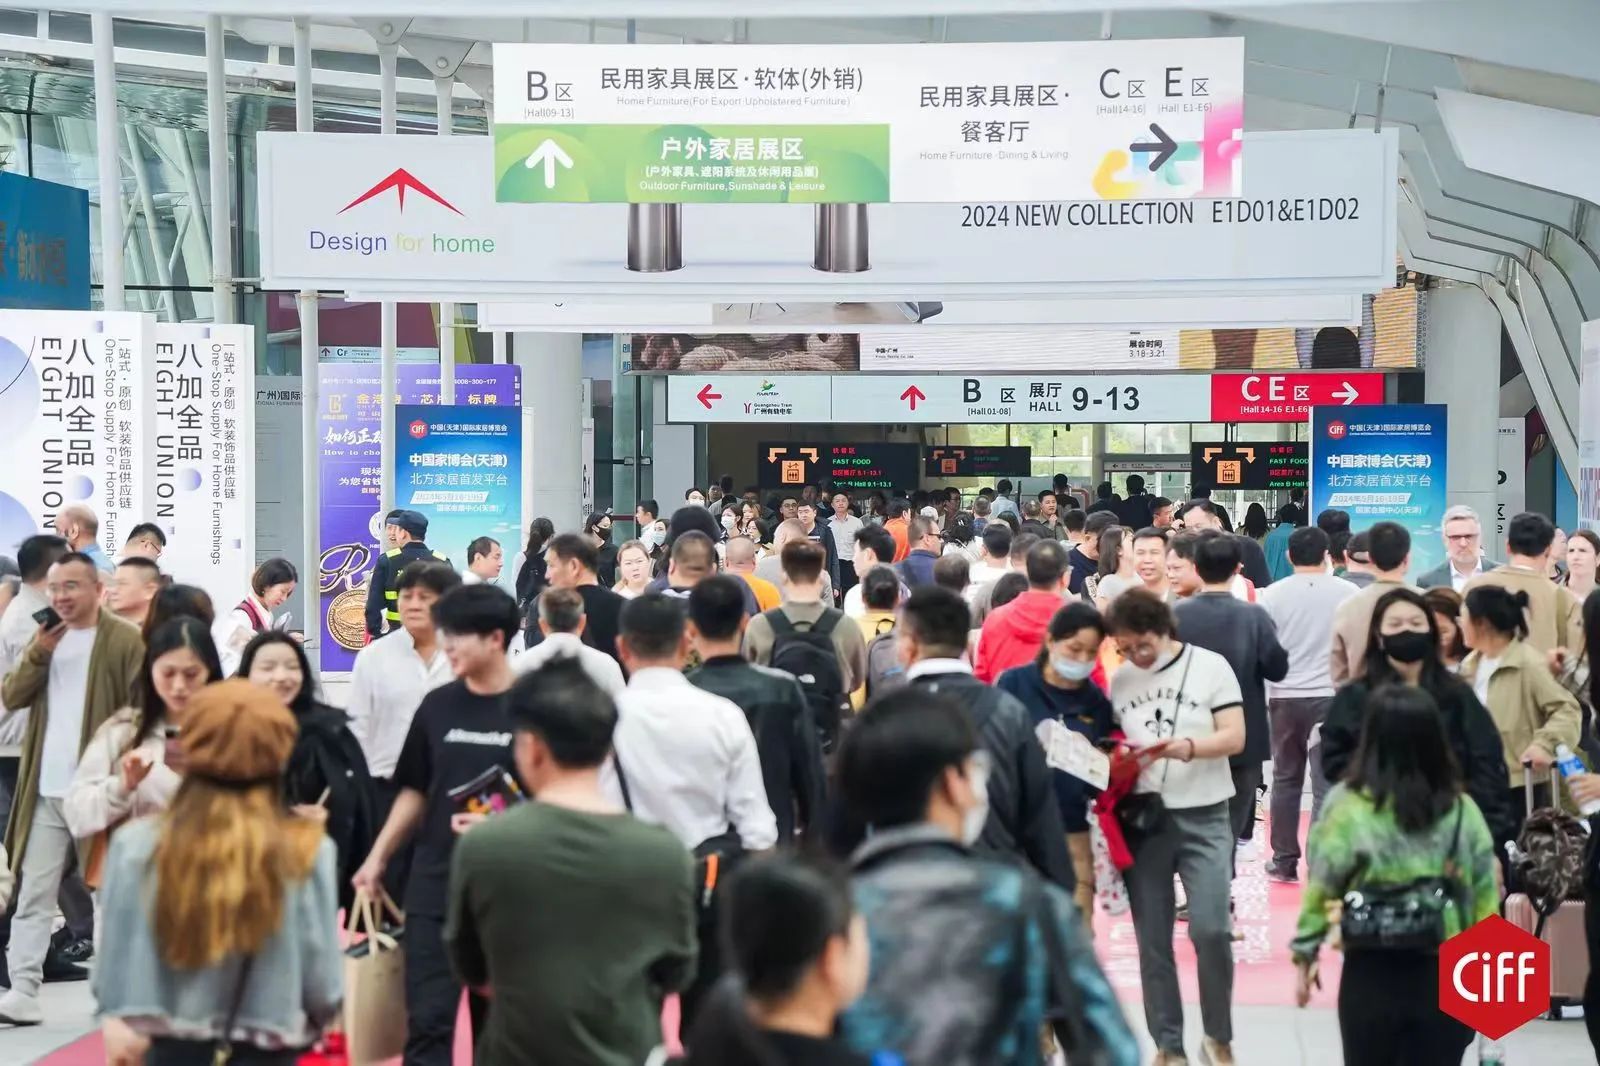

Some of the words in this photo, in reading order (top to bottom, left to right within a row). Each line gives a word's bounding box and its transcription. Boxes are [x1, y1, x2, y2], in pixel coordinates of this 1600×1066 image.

[601, 66, 863, 92] 民用家具展区·软体(外销)
[616, 95, 645, 105] Home
[647, 95, 709, 106] Furniture(For
[711, 96, 741, 107] Export
[804, 96, 851, 106] Furniture)
[960, 120, 1030, 143] 餐客厅
[660, 136, 804, 160] 户外家居展区
[919, 151, 948, 160] Home
[950, 151, 993, 160] Furniture
[1031, 151, 1038, 159] &
[1040, 150, 1069, 161] Living
[639, 180, 679, 191] Outdoor
[779, 181, 787, 190] &
[789, 181, 826, 191] Leisure
[961, 204, 1010, 228] 2024
[1015, 203, 1061, 227] NEW
[1067, 200, 1194, 226] COLLECTION
[1212, 197, 1360, 223] E1D01&E1D02
[310, 231, 388, 256] Design
[394, 233, 424, 251] for
[432, 232, 495, 253] home
[1129, 339, 1163, 348] 展会时间
[42, 337, 63, 422] EIGHT
[104, 338, 117, 398] One-Stop
[118, 338, 132, 411] 一站式·原创
[211, 343, 222, 397] One-Stop
[223, 343, 236, 410] 一站式·原创
[156, 343, 174, 420] EIGHT
[65, 338, 96, 466] 八加全品
[176, 343, 203, 460] 八加全品
[468, 394, 497, 405] 标牌
[1029, 382, 1063, 398] 展厅
[1072, 386, 1140, 412] 9-13
[1029, 401, 1063, 412] HALL
[1260, 405, 1283, 413] 14-16
[103, 401, 117, 443] Supply
[210, 401, 222, 438] Supply
[430, 423, 508, 431] 中国(天津)国际家居博览会
[1349, 423, 1432, 432] 中国(天津)国际家居博览会
[105, 446, 117, 468] For
[212, 442, 223, 460] For
[223, 418, 237, 499] 软装饰品供应链
[409, 453, 508, 467] 中国家博会(天津)
[1327, 454, 1432, 468] 中国家博会(天津)
[118, 420, 133, 509] 软装饰品供应链
[156, 435, 175, 517] UNION
[105, 471, 117, 508] Home
[212, 465, 223, 498] Home
[409, 472, 508, 486] 北方家居首发平台
[1327, 474, 1432, 487] 北方家居首发平台
[436, 504, 499, 512] 国家会展中心(天津)
[1355, 505, 1422, 514] 国家会展中心(天津)
[211, 501, 223, 565] Furnishings
